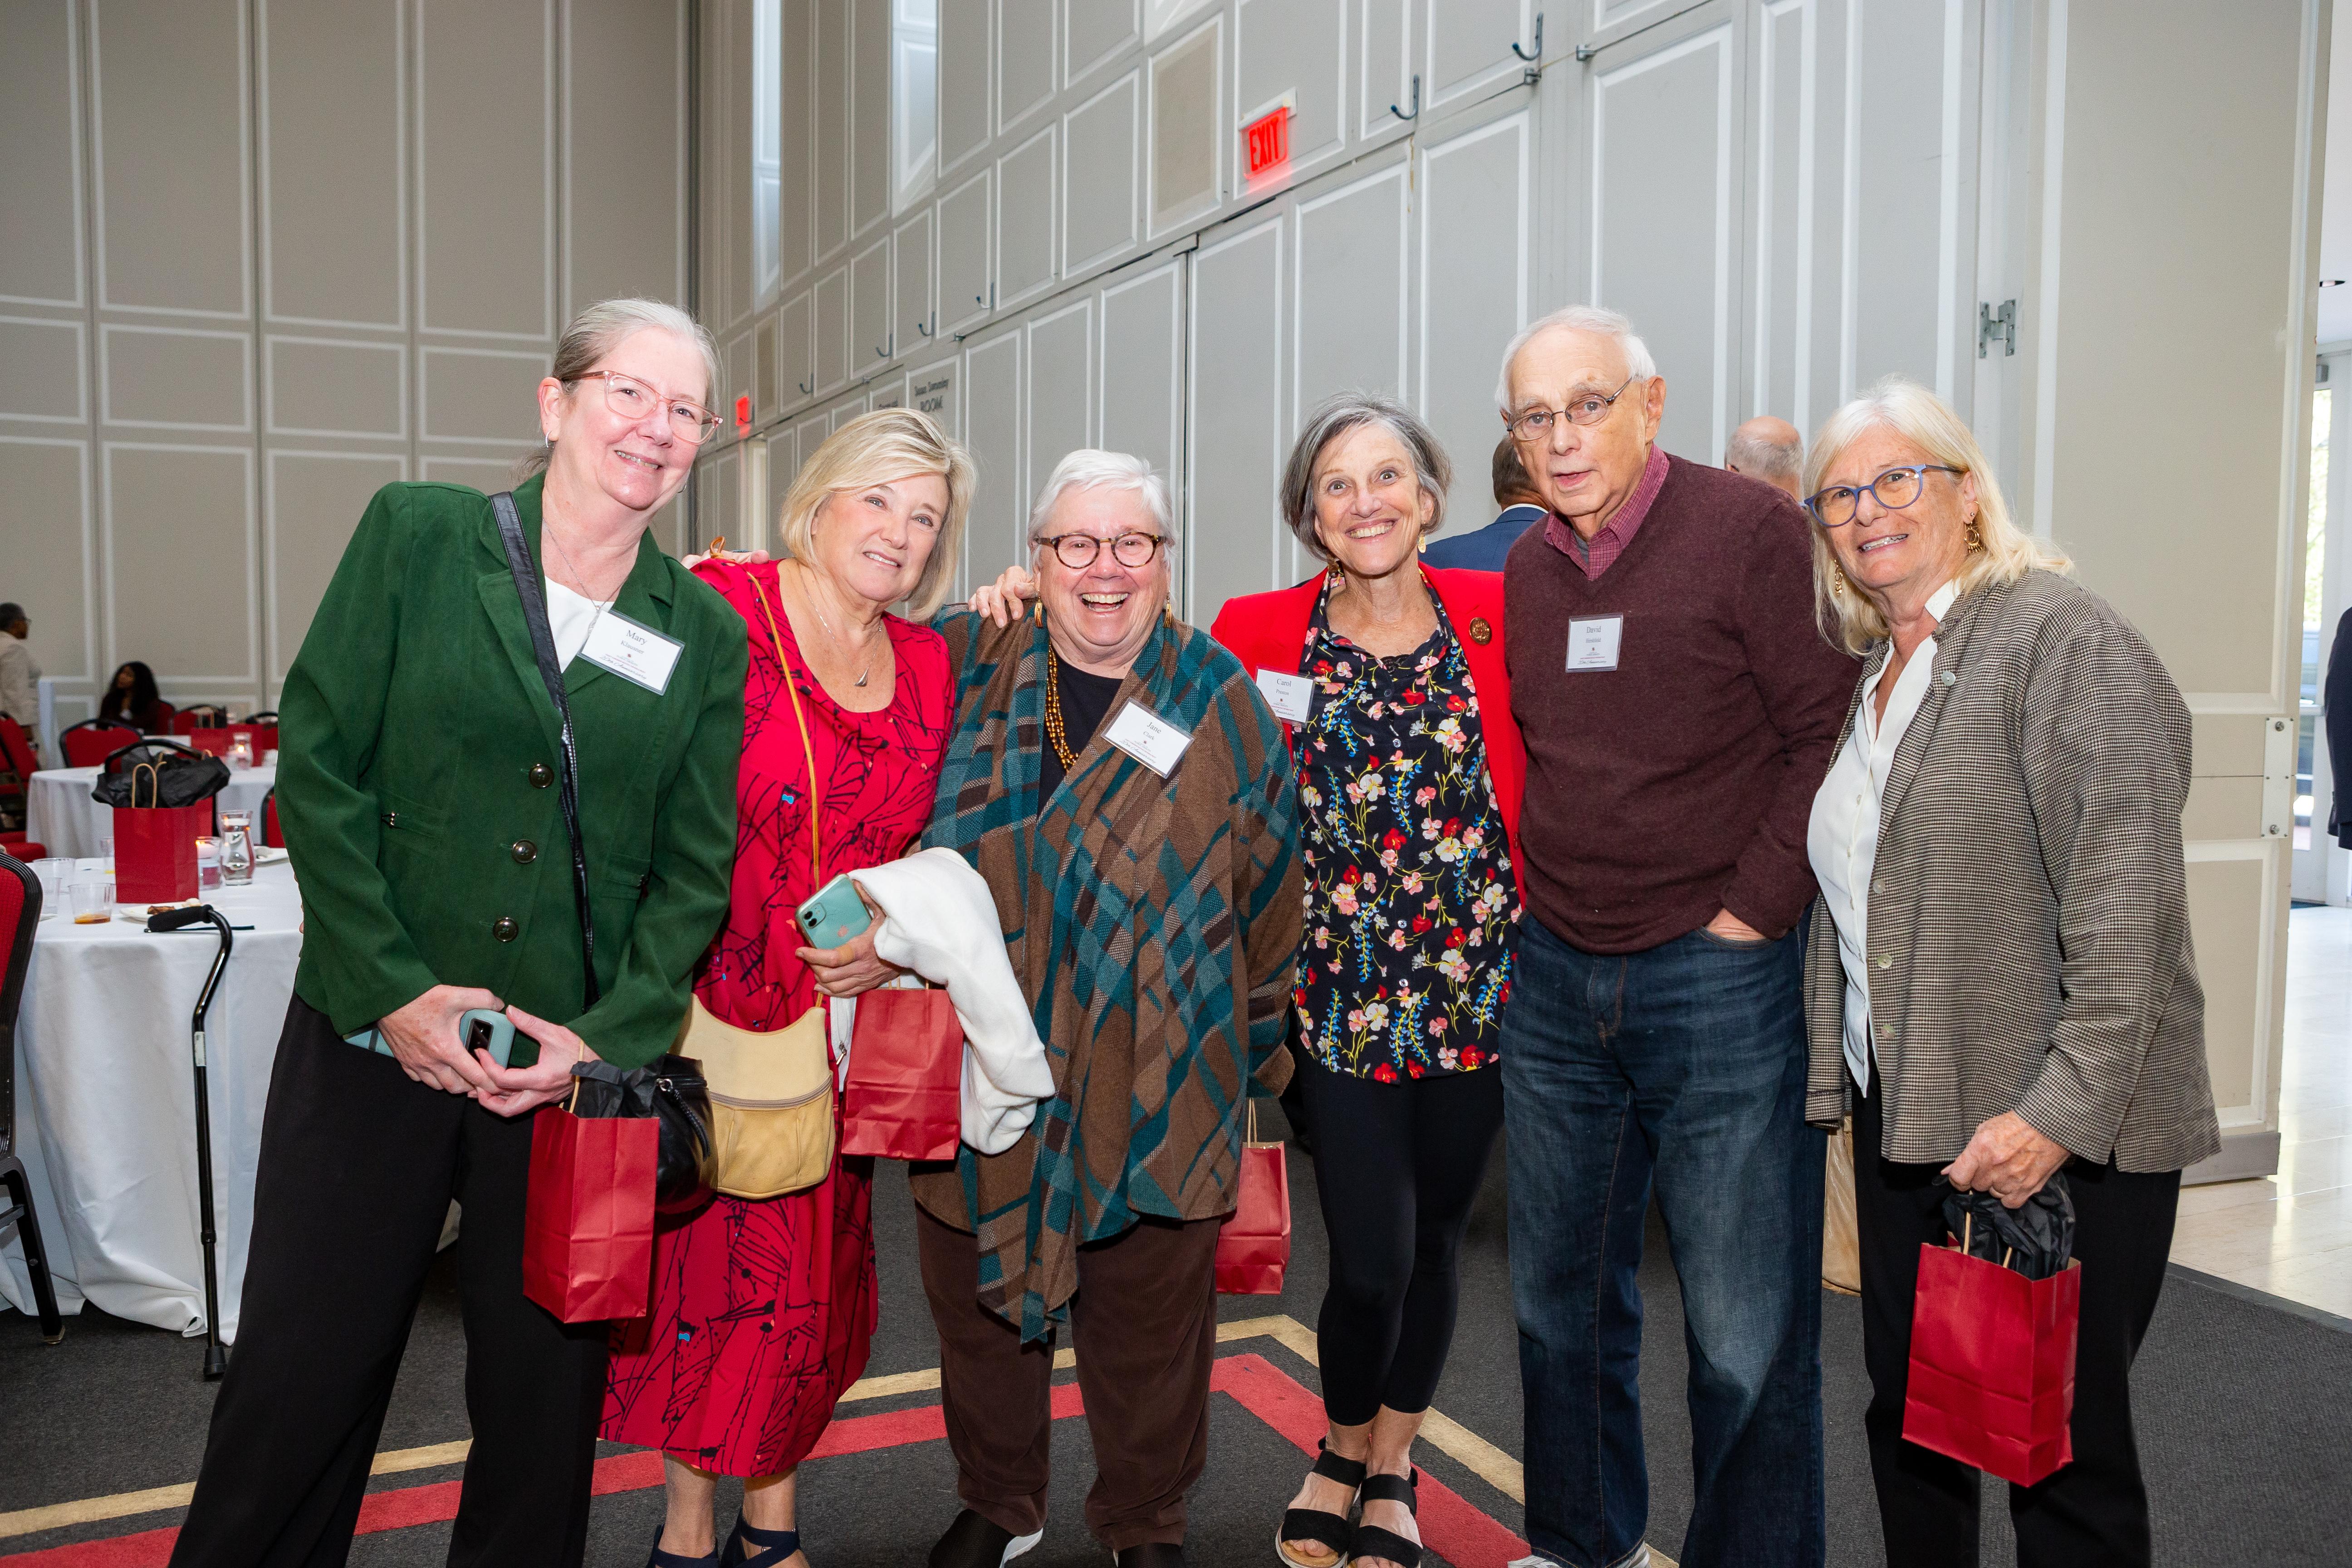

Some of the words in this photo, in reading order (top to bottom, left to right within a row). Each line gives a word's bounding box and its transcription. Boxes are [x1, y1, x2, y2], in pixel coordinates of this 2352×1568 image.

[1249, 116, 1279, 172] EXIT
[626, 630, 647, 645] Mary
[621, 640, 645, 654] Klausner
[1277, 678, 1292, 687] Carol
[1147, 722, 1161, 734] Jane
[1143, 730, 1154, 740] Clark
